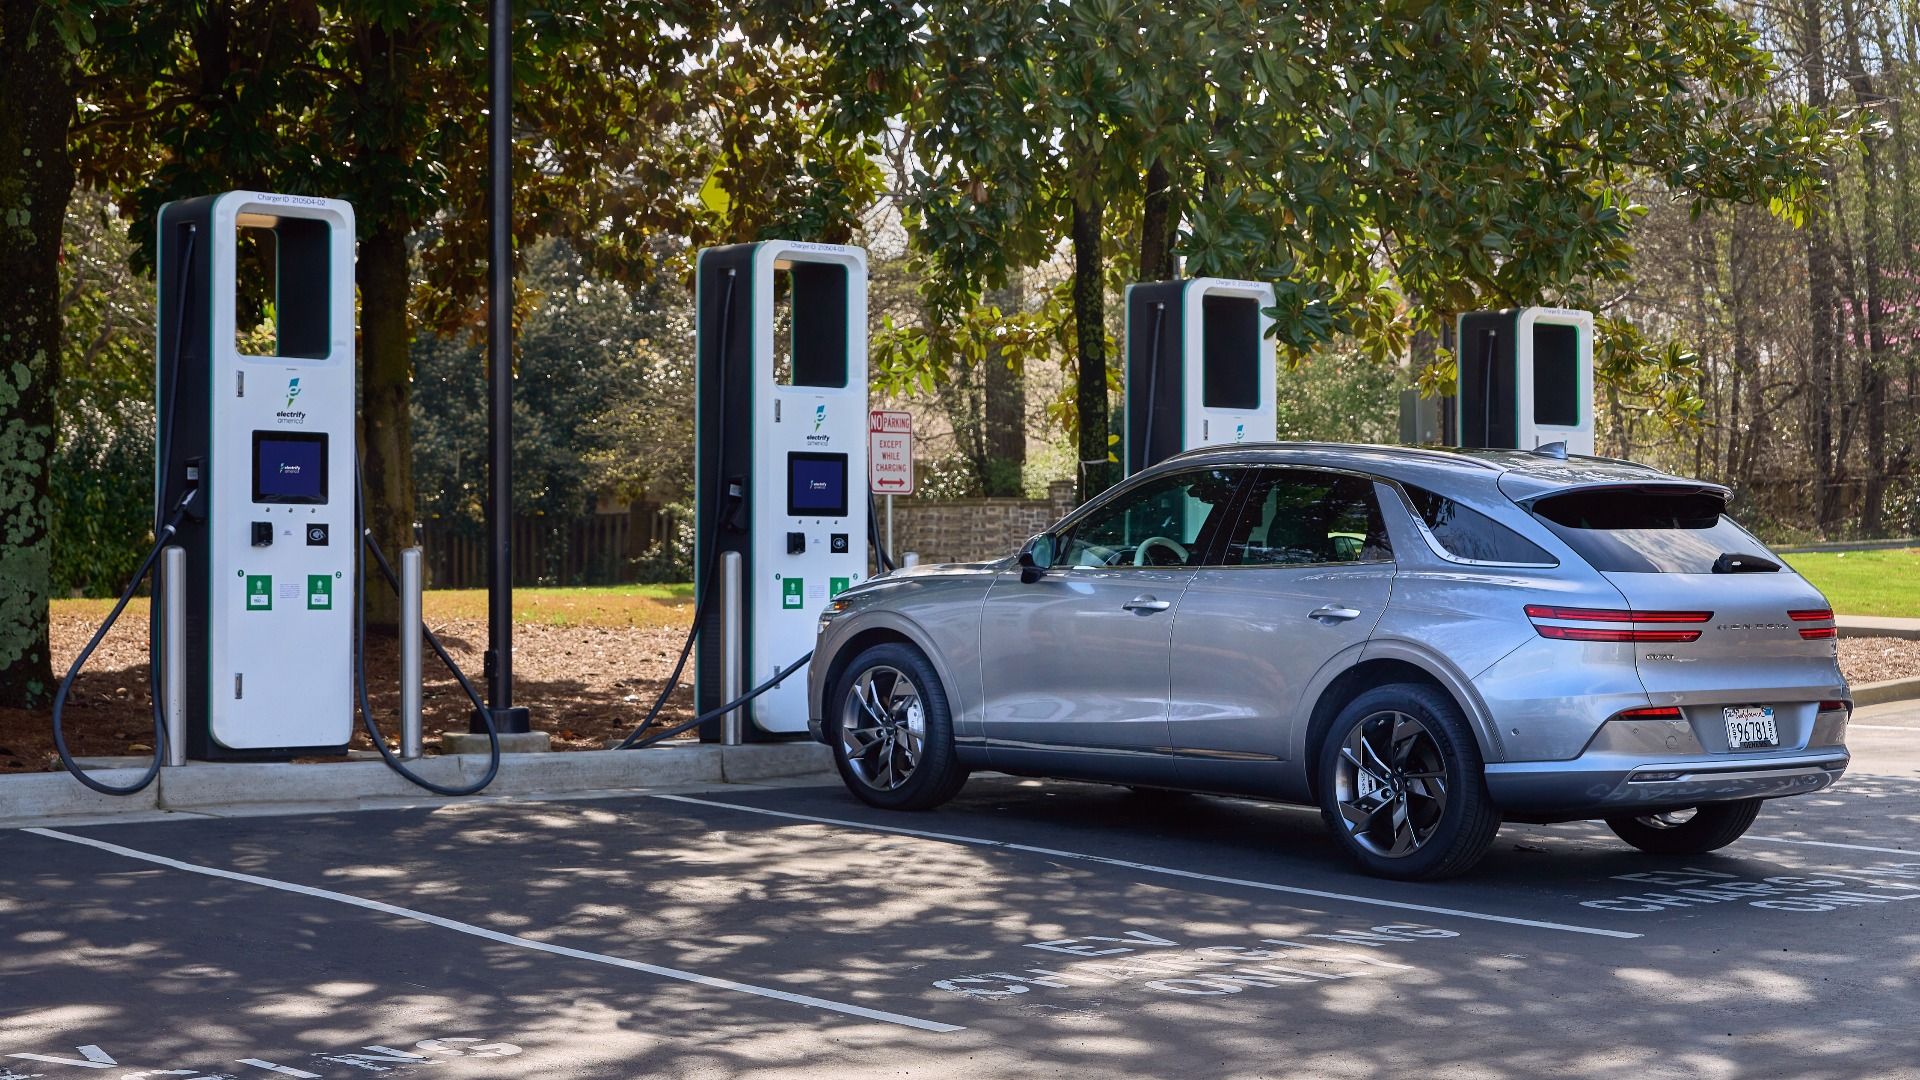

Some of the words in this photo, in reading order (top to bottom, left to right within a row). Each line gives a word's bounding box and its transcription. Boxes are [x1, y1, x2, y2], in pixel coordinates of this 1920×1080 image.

[257, 193, 281, 203] Charger
[276, 411, 306, 420] electrify
[870, 413, 882, 431] NO
[883, 417, 910, 429] PARKING
[806, 434, 830, 442] electrify
[879, 439, 903, 449] EXCEPT
[882, 451, 901, 461] WHILE
[875, 463, 907, 473] CHARGING
[1736, 721, 1769, 742] 96781
[1608, 867, 1740, 886] EV
[1022, 930, 1181, 957] EV
[931, 924, 1462, 995] CHARGING
[1144, 954, 1416, 995] ONLY
